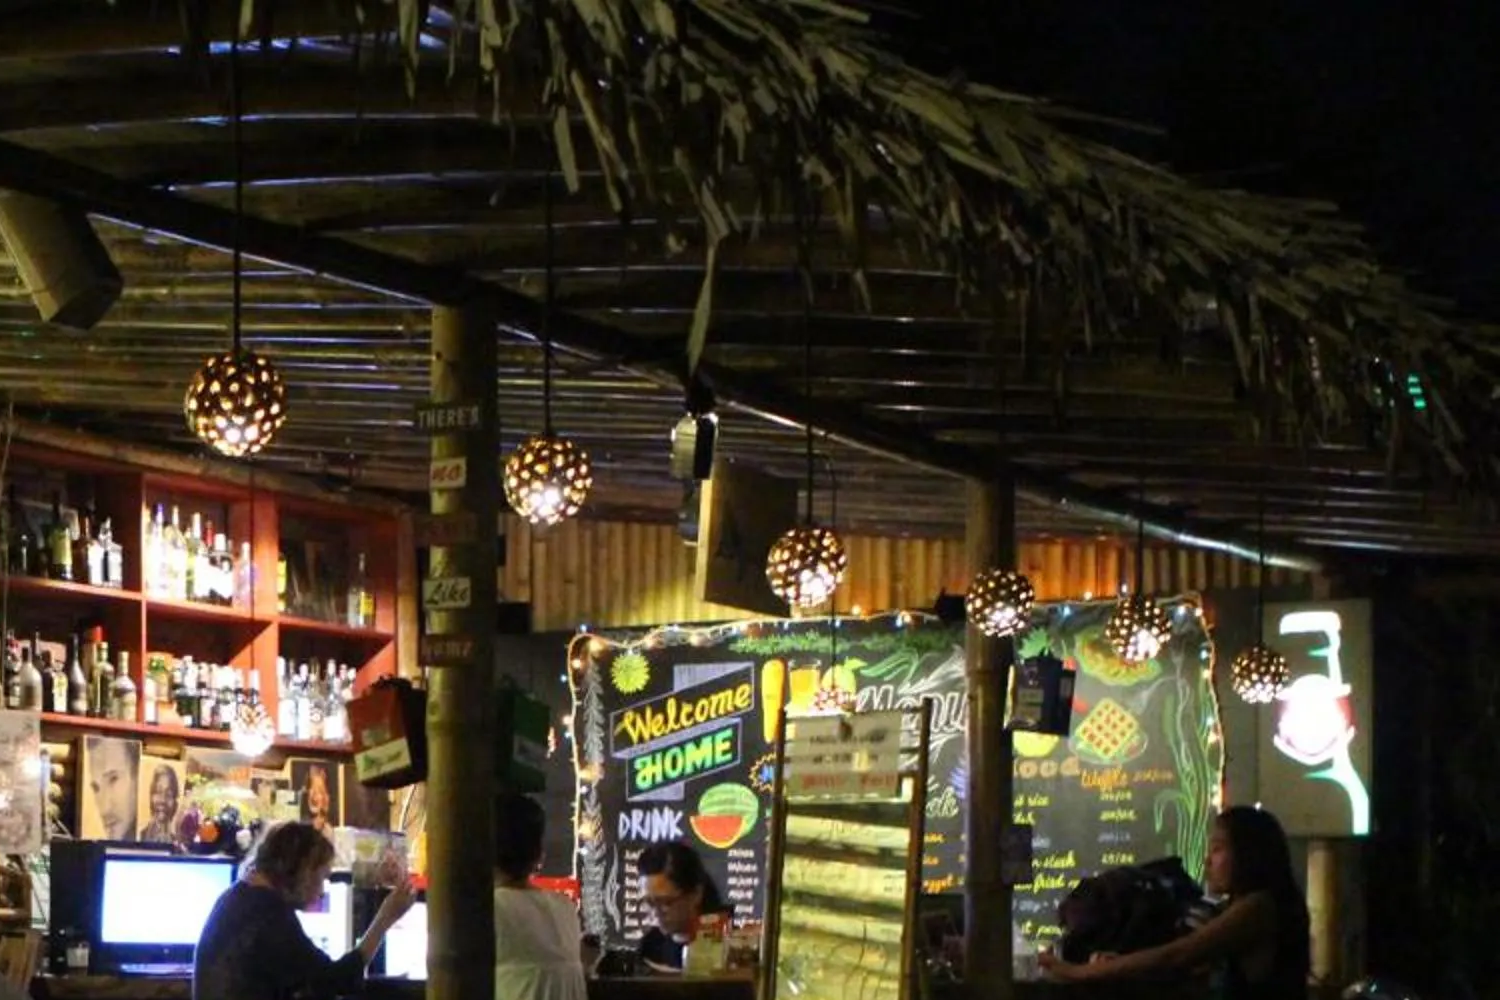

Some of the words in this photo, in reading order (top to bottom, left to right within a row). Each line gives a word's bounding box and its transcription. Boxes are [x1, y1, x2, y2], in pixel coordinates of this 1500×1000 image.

[613, 682, 752, 745] Welcome
[633, 728, 735, 791] HOME
[617, 805, 685, 844] DRINK
